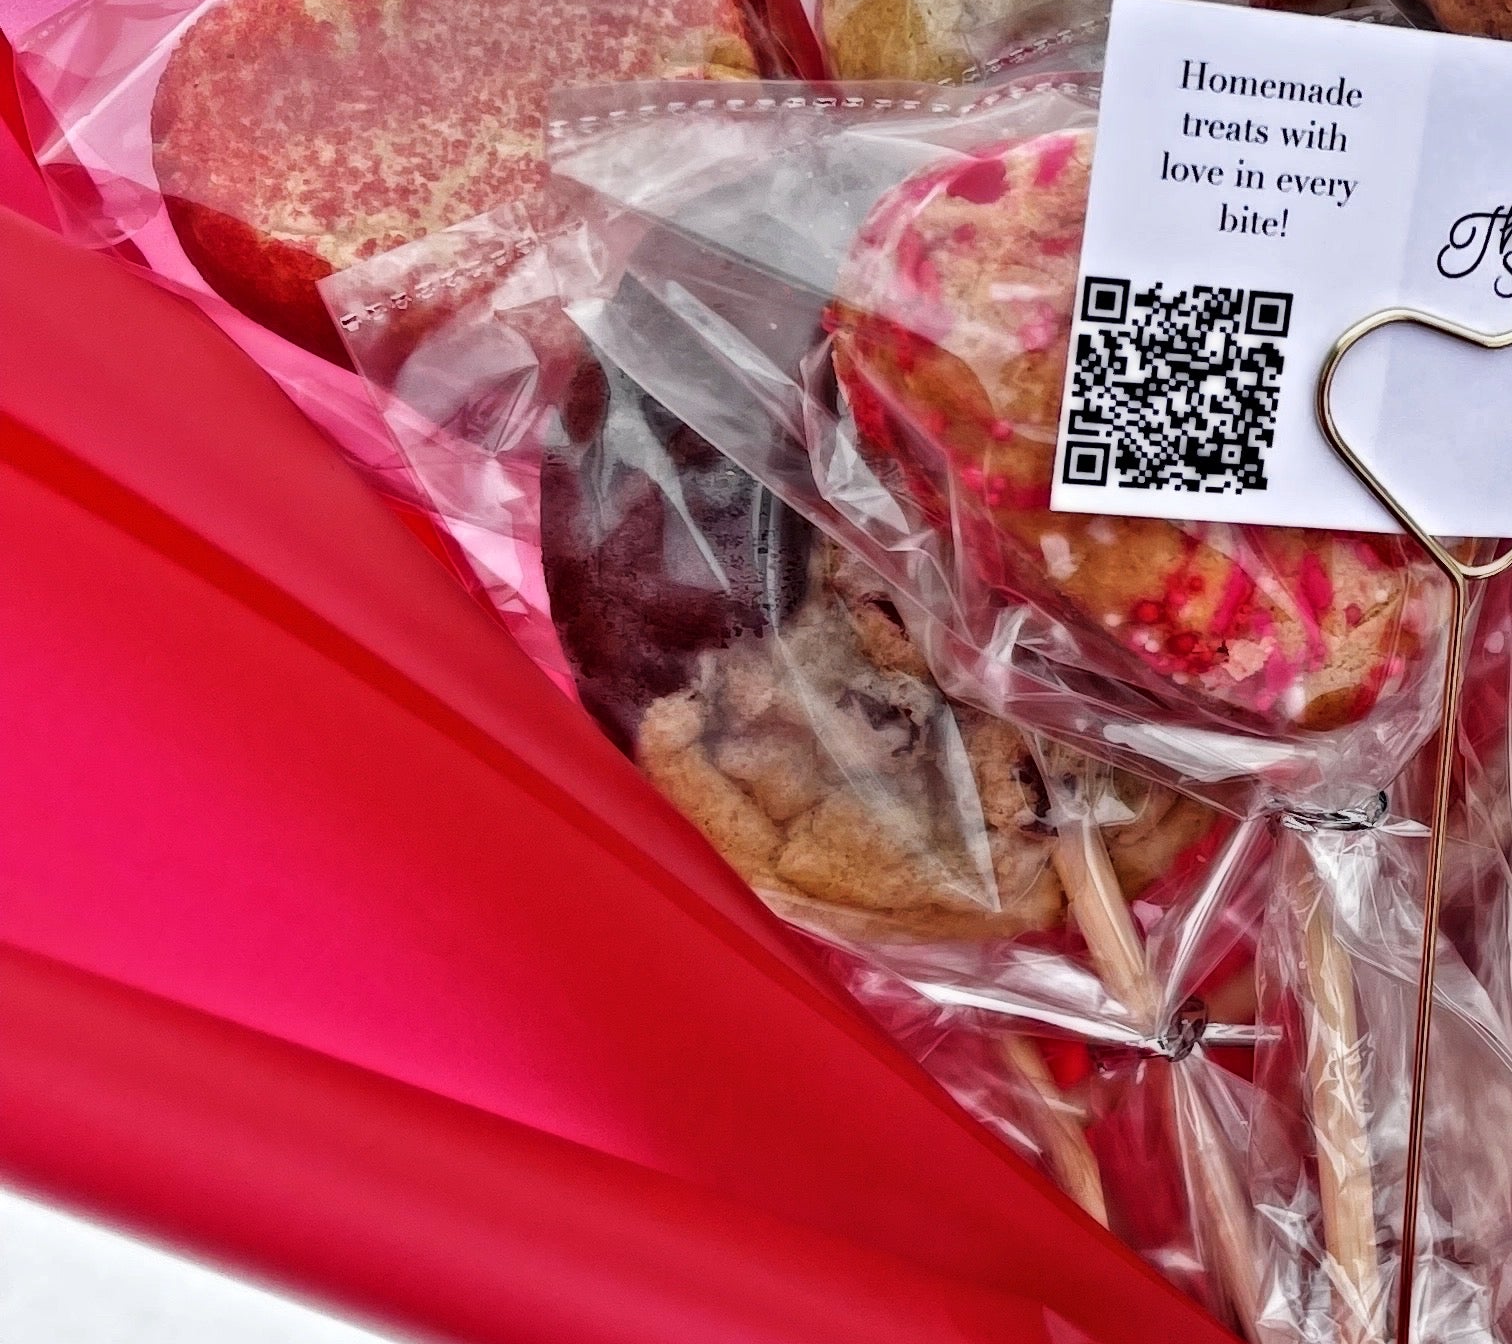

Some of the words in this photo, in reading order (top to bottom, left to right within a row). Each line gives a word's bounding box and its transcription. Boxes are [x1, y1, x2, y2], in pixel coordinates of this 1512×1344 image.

[1178, 59, 1364, 108] Homemade
[1182, 112, 1269, 144] treats
[1281, 119, 1348, 152] with
[1160, 151, 1224, 186] love
[1234, 159, 1265, 190] in
[1276, 174, 1359, 207] every
[1218, 203, 1290, 237] bite!
